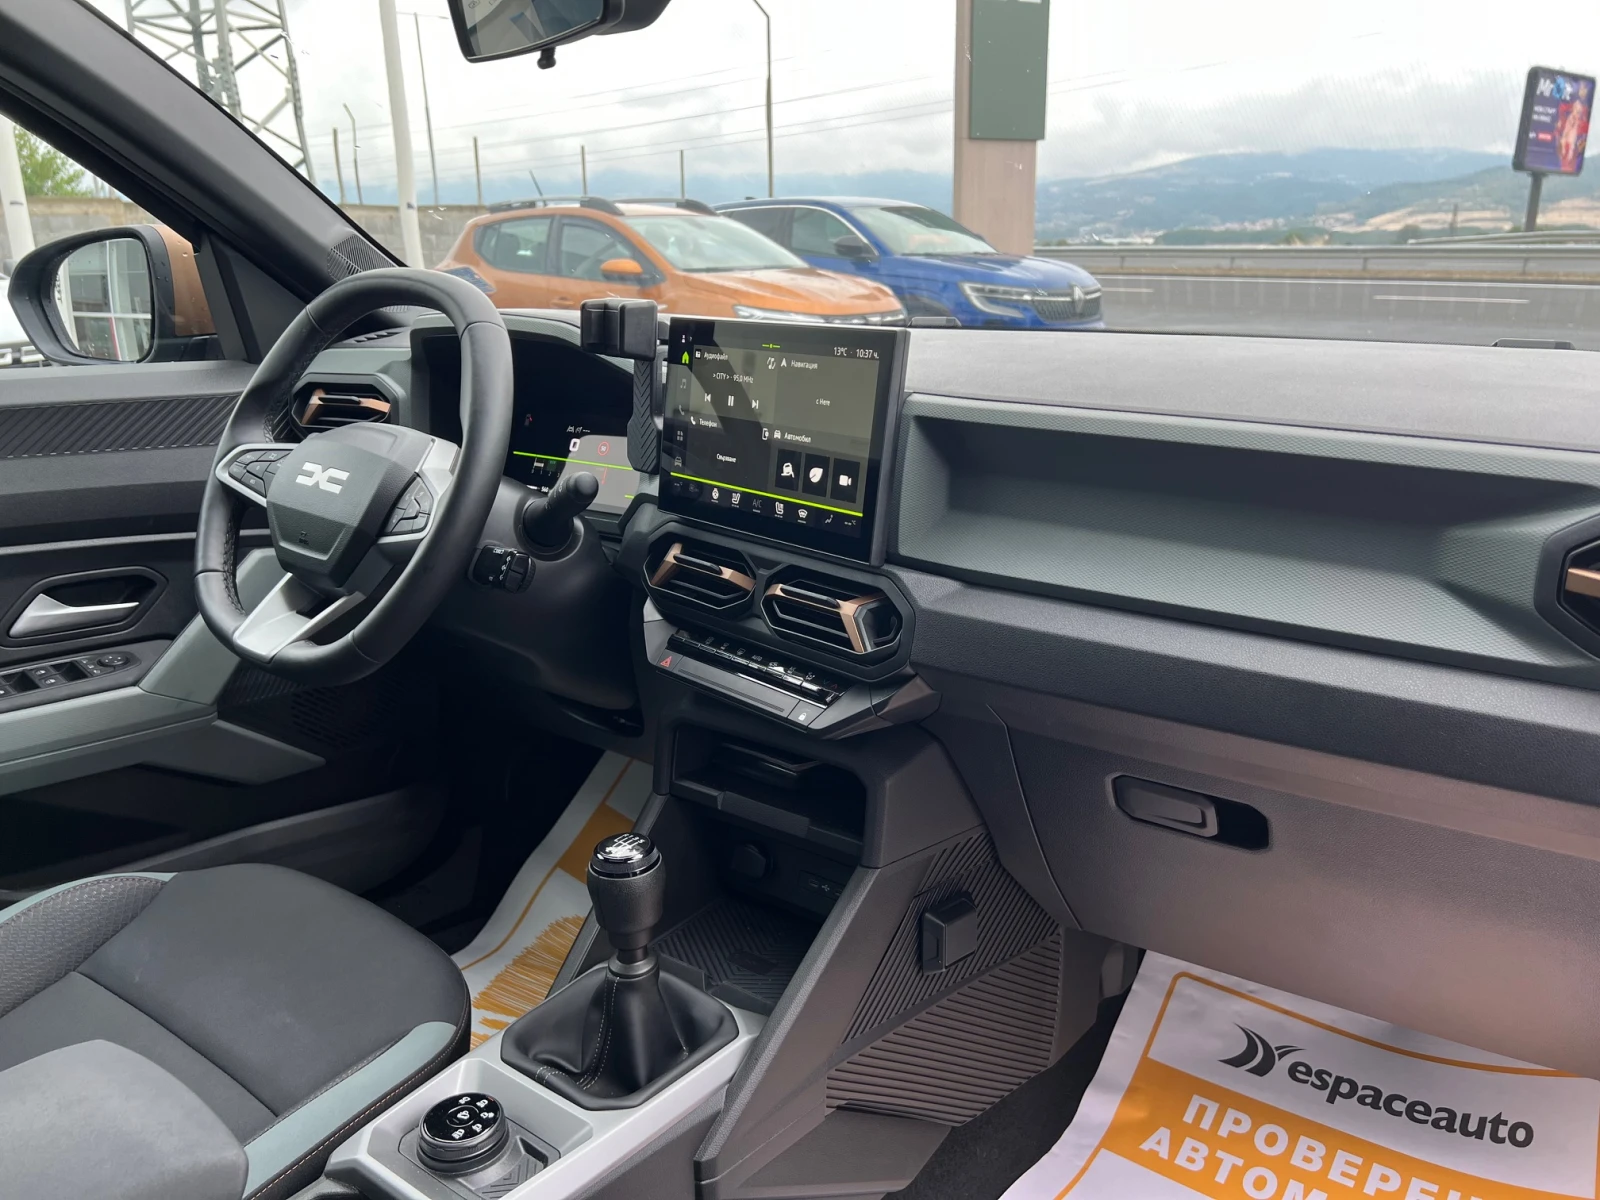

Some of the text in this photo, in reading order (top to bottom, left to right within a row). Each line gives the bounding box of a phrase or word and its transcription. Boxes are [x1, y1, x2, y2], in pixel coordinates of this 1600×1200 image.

[856, 348, 873, 359] 10:37
[790, 359, 818, 370] Навигация
[743, 375, 754, 384] MHz
[699, 418, 718, 429] Телефон
[783, 432, 812, 443] Автомобил
[1287, 1060, 1534, 1148] espaceauto
